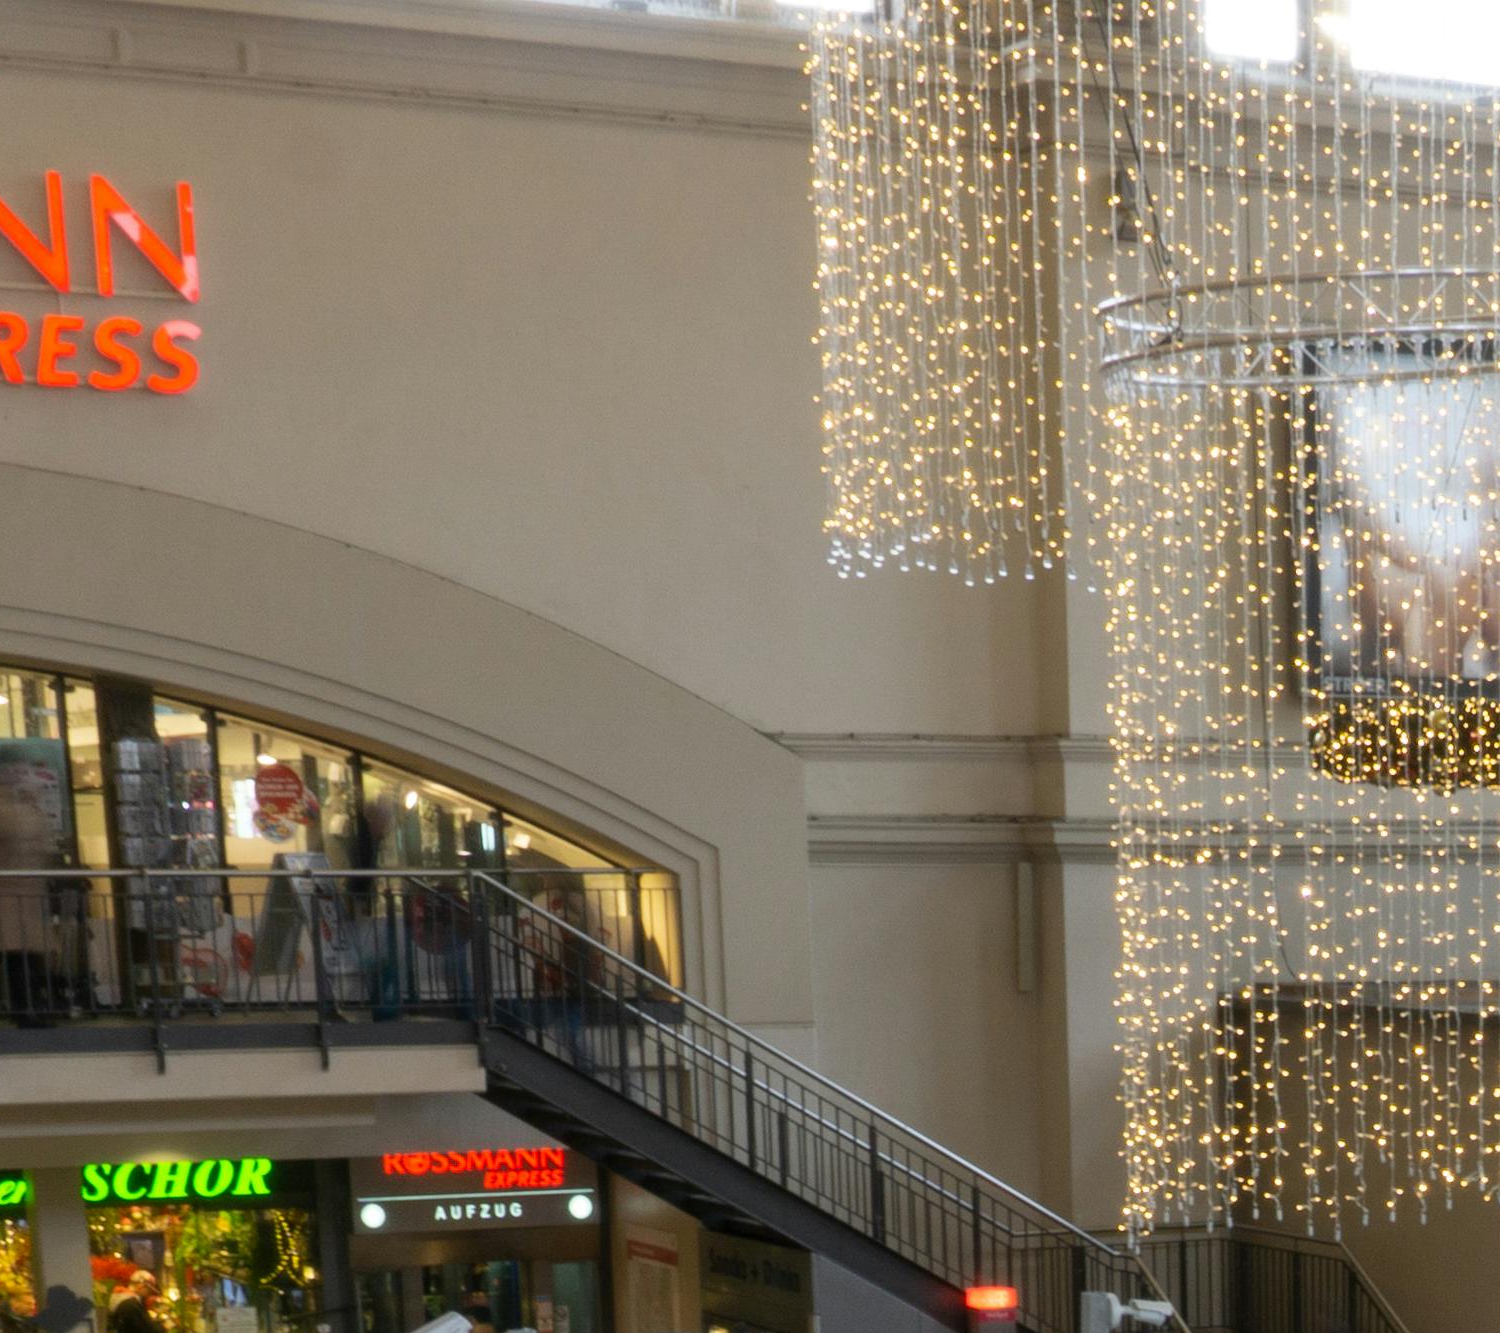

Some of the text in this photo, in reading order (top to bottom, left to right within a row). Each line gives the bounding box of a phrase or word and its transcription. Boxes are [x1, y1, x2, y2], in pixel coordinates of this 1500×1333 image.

[383, 1147, 566, 1176] ROSSMANN
[82, 1157, 272, 1201] SCHOR
[483, 1168, 565, 1190] EXPRESS
[434, 1203, 523, 1221] AUFZUG
